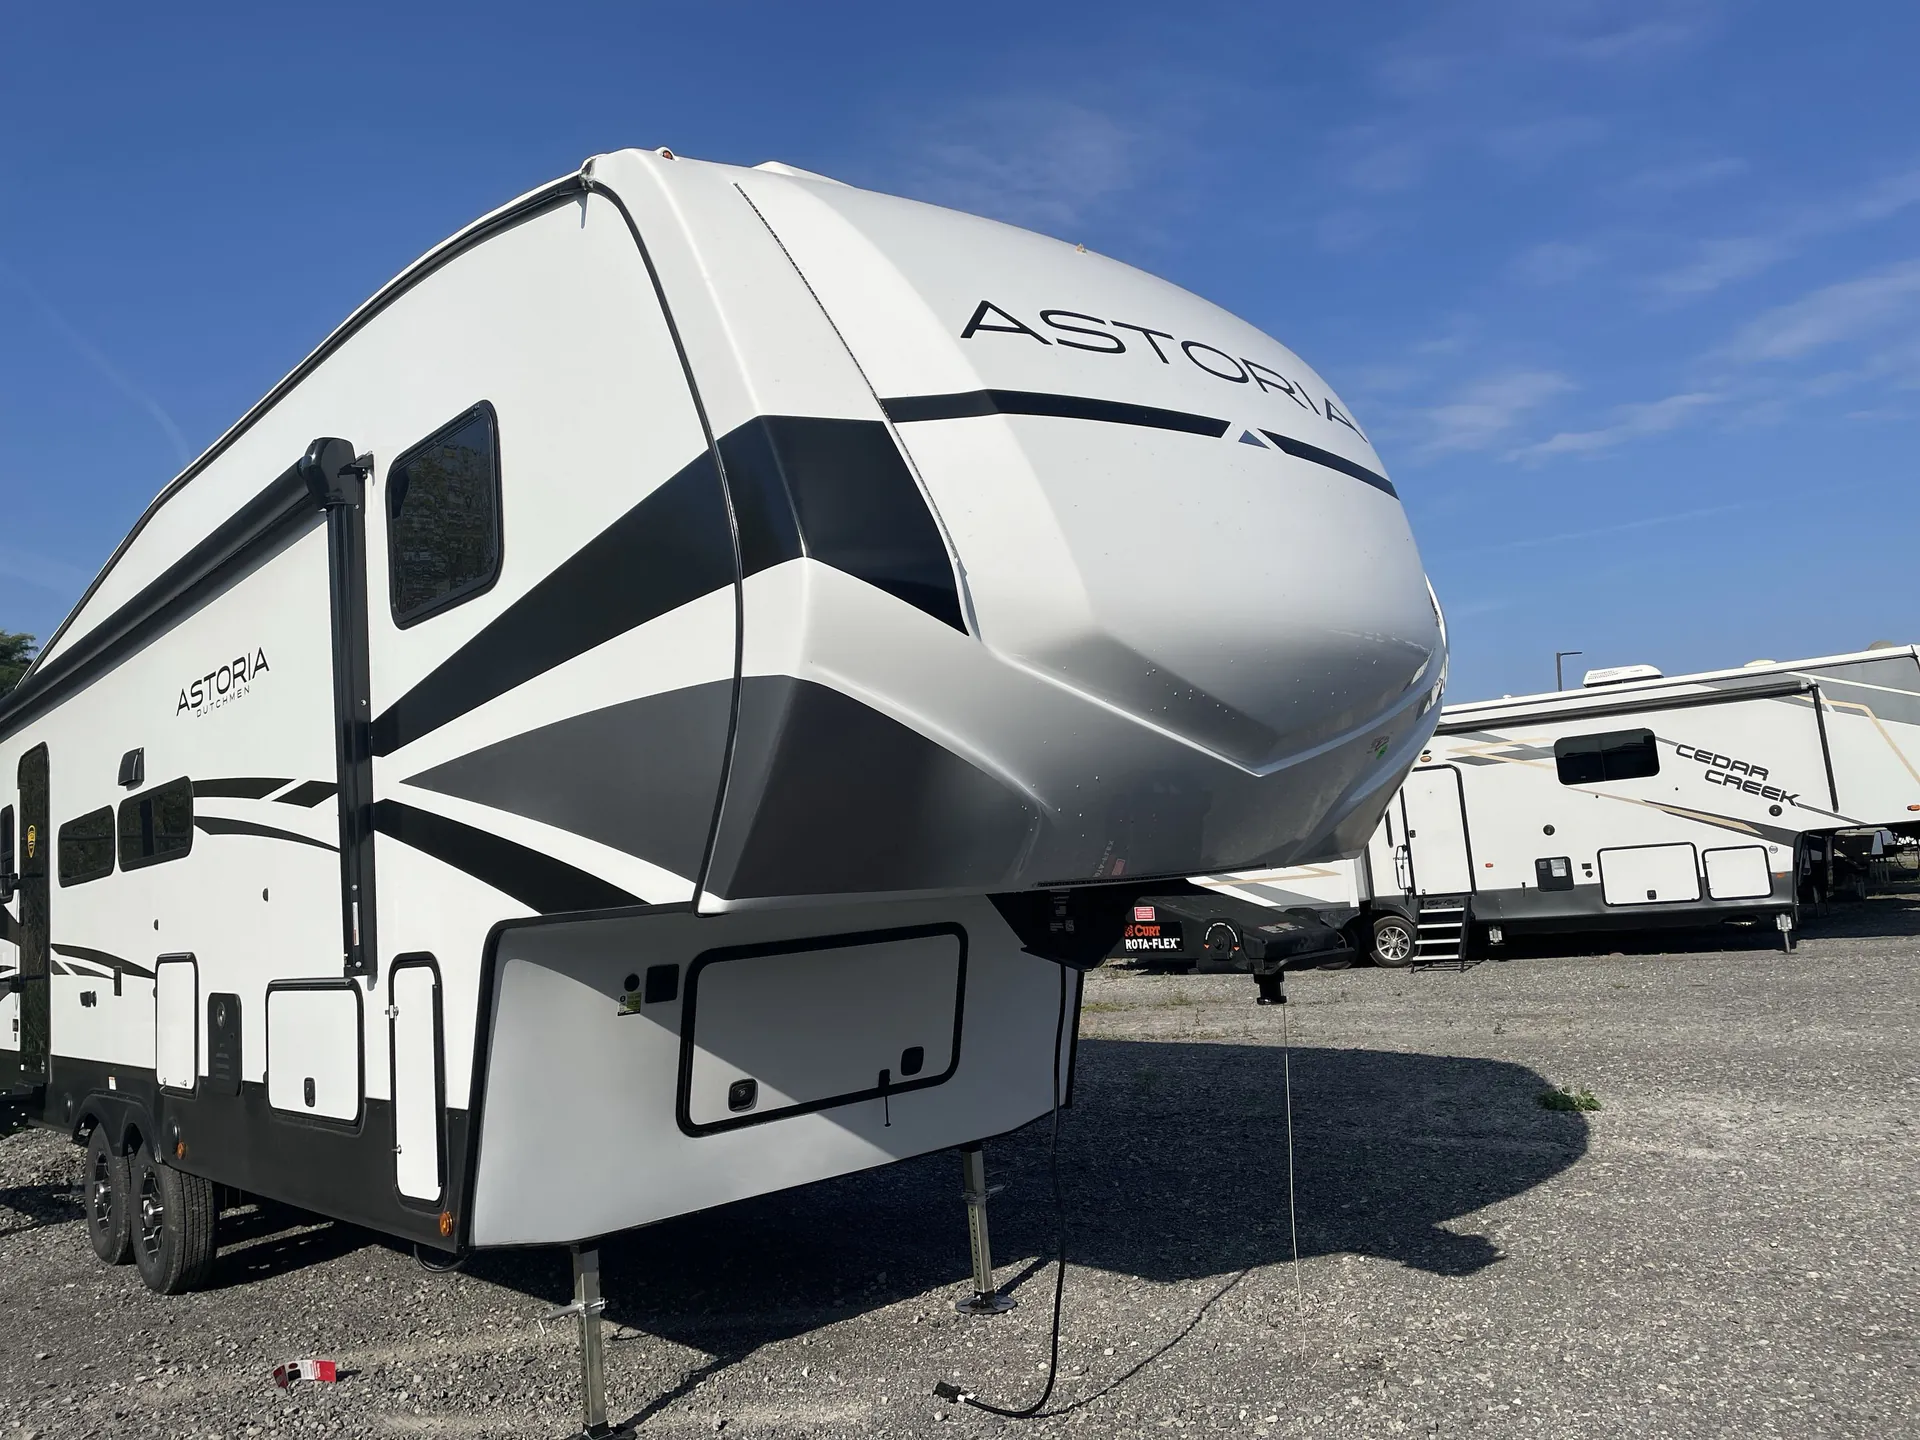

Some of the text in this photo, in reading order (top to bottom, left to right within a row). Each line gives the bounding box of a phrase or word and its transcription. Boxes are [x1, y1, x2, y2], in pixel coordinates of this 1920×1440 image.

[960, 300, 1368, 444] ASTORIA
[176, 647, 270, 716] ASTORIA
[196, 685, 250, 718] DUTCHMEN
[1676, 744, 1769, 781] CEDAR
[1704, 769, 1801, 807] CREEK
[1134, 925, 1160, 937] CURT
